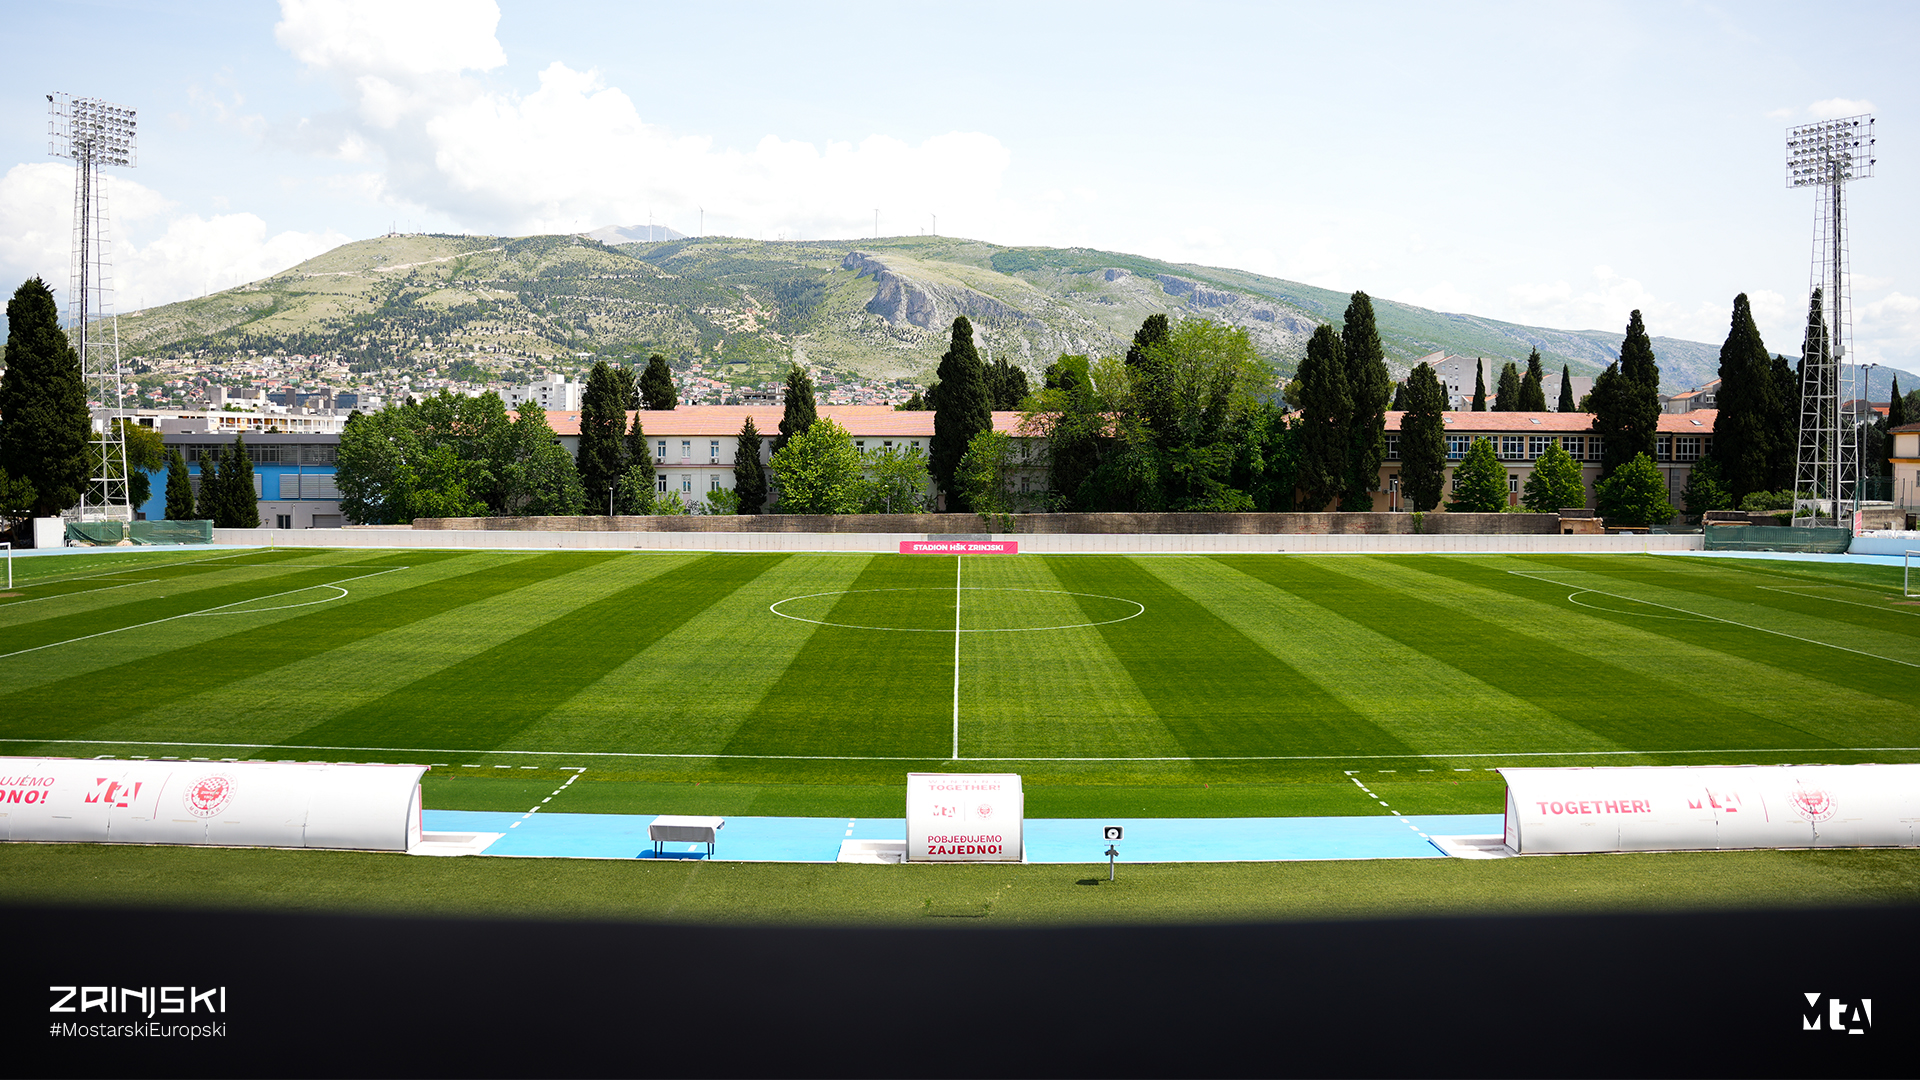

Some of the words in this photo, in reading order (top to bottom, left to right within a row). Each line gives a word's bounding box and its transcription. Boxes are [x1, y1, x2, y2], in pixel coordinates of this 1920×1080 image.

[949, 543, 967, 551] HŠK
[1536, 799, 1651, 815] TOGETHER!
[927, 835, 1003, 844] POBJEĐUJEMO
[927, 845, 1003, 855] ZAJEDNO!
